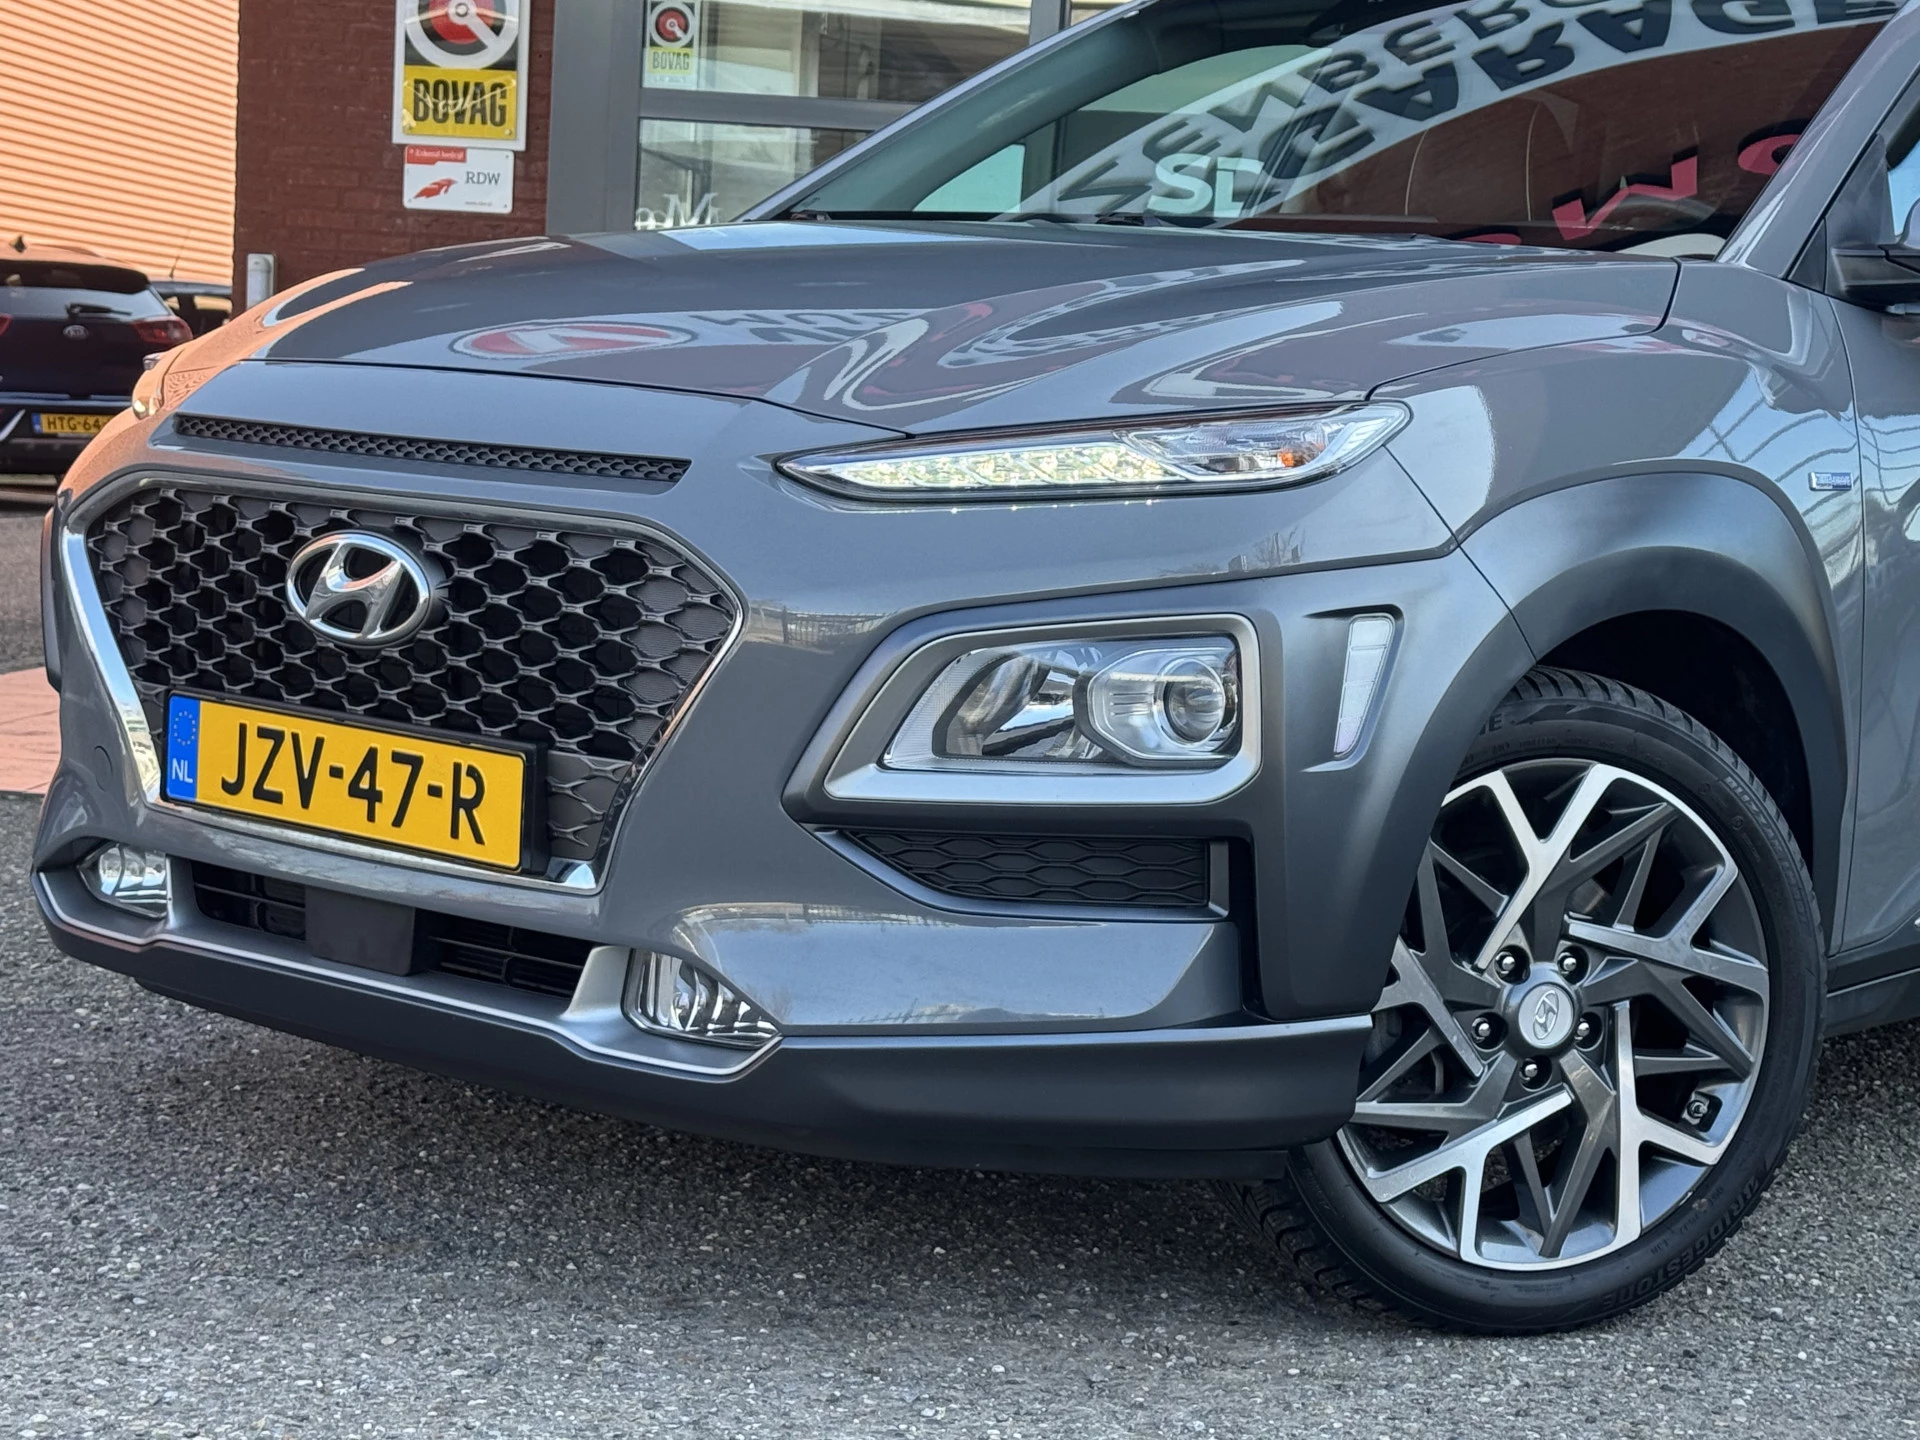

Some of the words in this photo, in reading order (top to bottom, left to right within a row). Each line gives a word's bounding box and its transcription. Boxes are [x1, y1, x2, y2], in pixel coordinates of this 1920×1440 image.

[652, 51, 690, 70] BOVAG
[413, 78, 507, 127] BOVAG
[465, 171, 501, 187] RDW
[47, 416, 104, 431] HTG-64
[172, 758, 193, 783] NL
[221, 722, 486, 846] JZV-47-R
